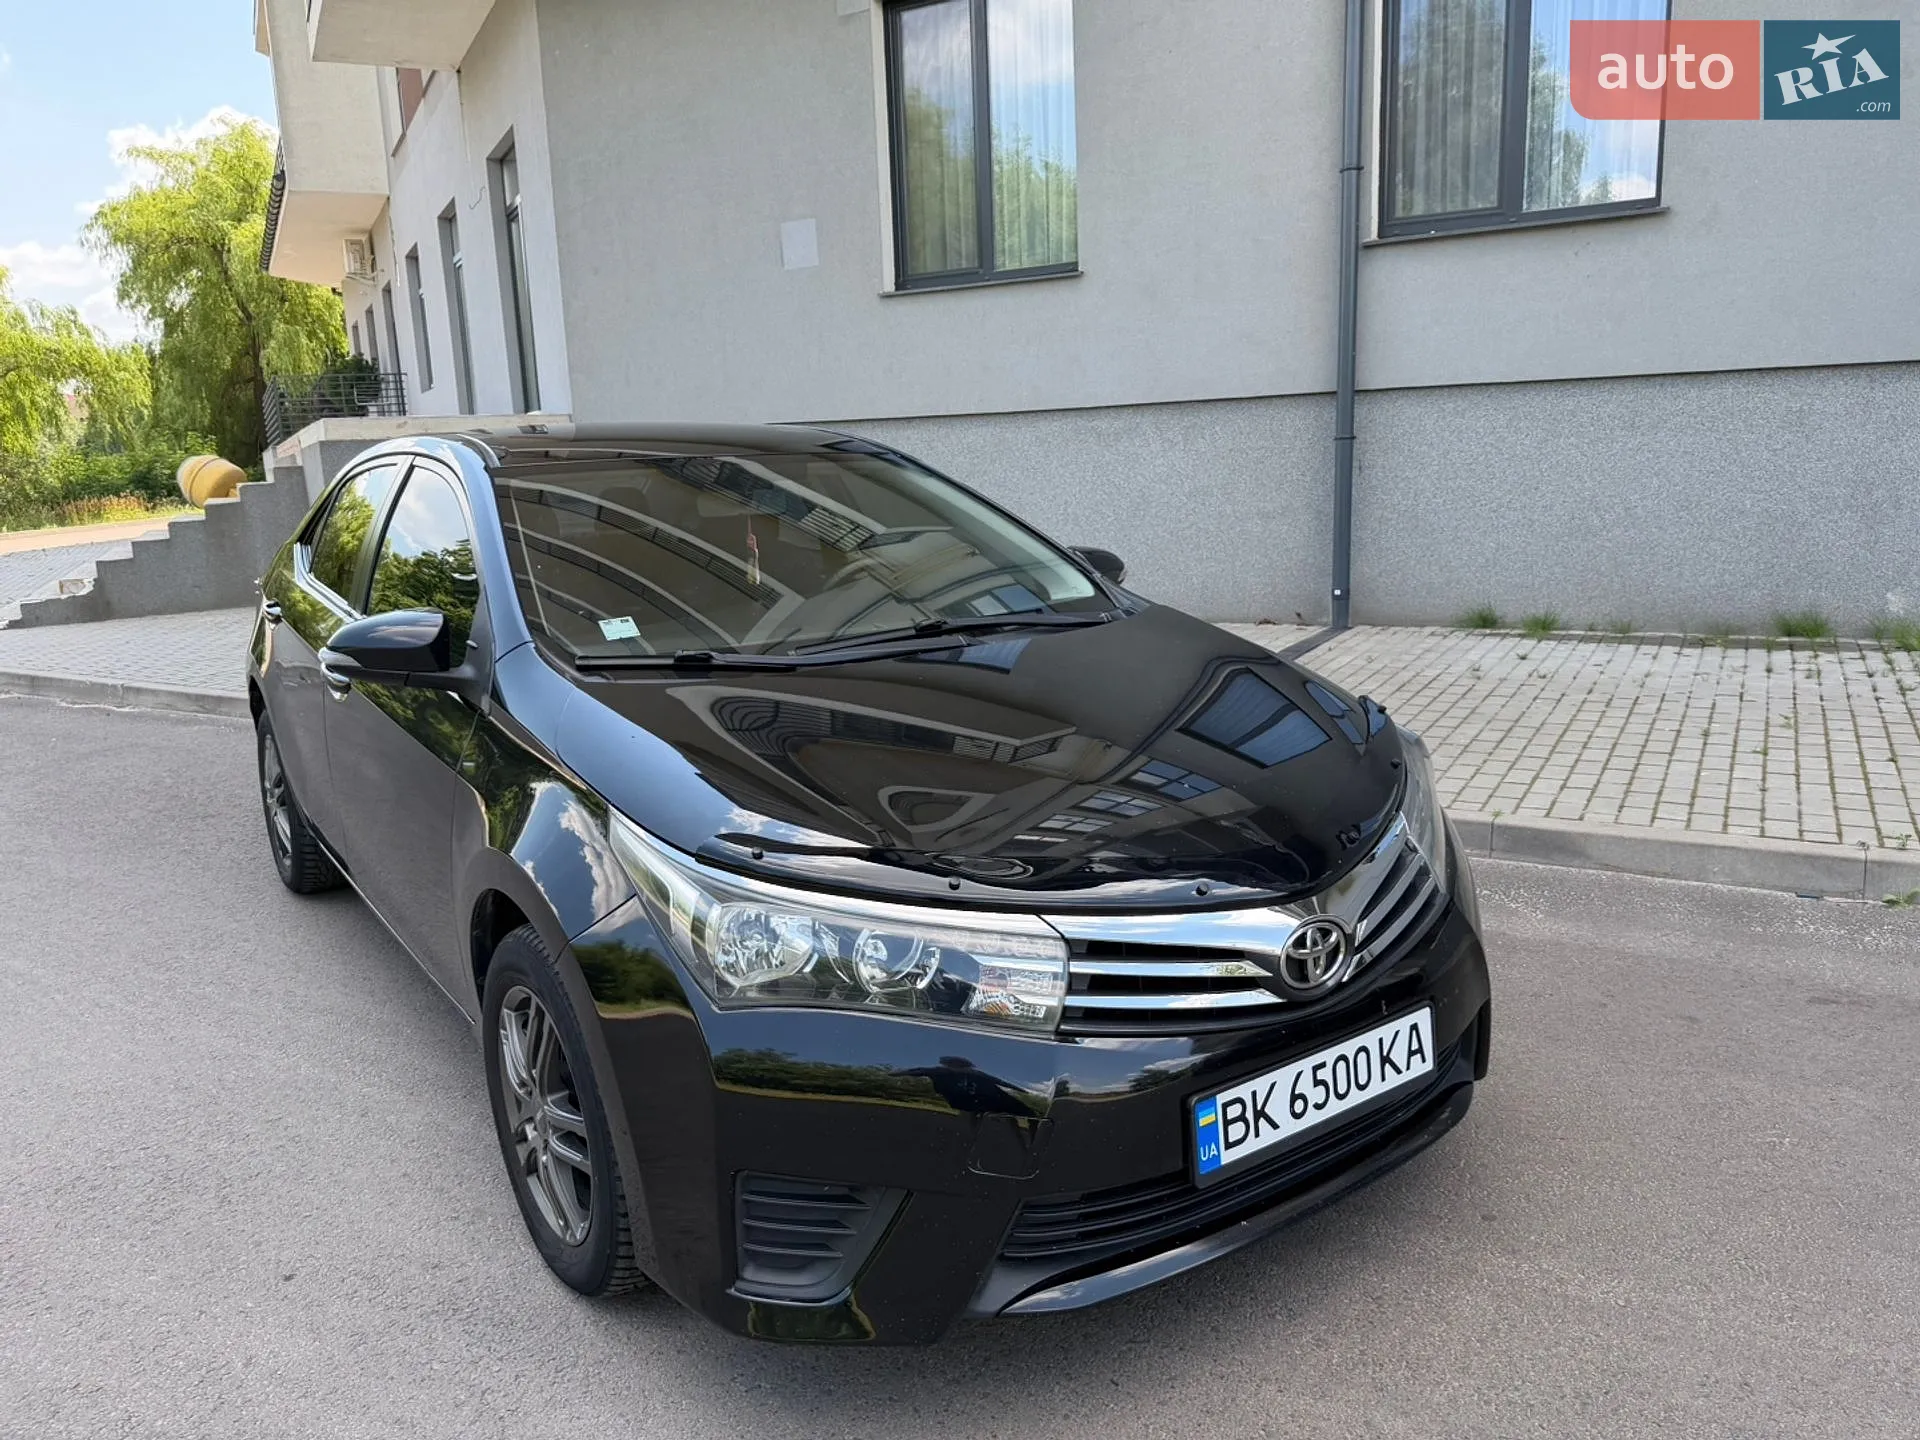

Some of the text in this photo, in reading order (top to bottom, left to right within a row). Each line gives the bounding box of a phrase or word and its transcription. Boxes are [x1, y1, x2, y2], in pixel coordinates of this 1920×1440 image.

[1221, 1022, 1427, 1152] BK 6500 KA
[1200, 1142, 1218, 1162] UA
